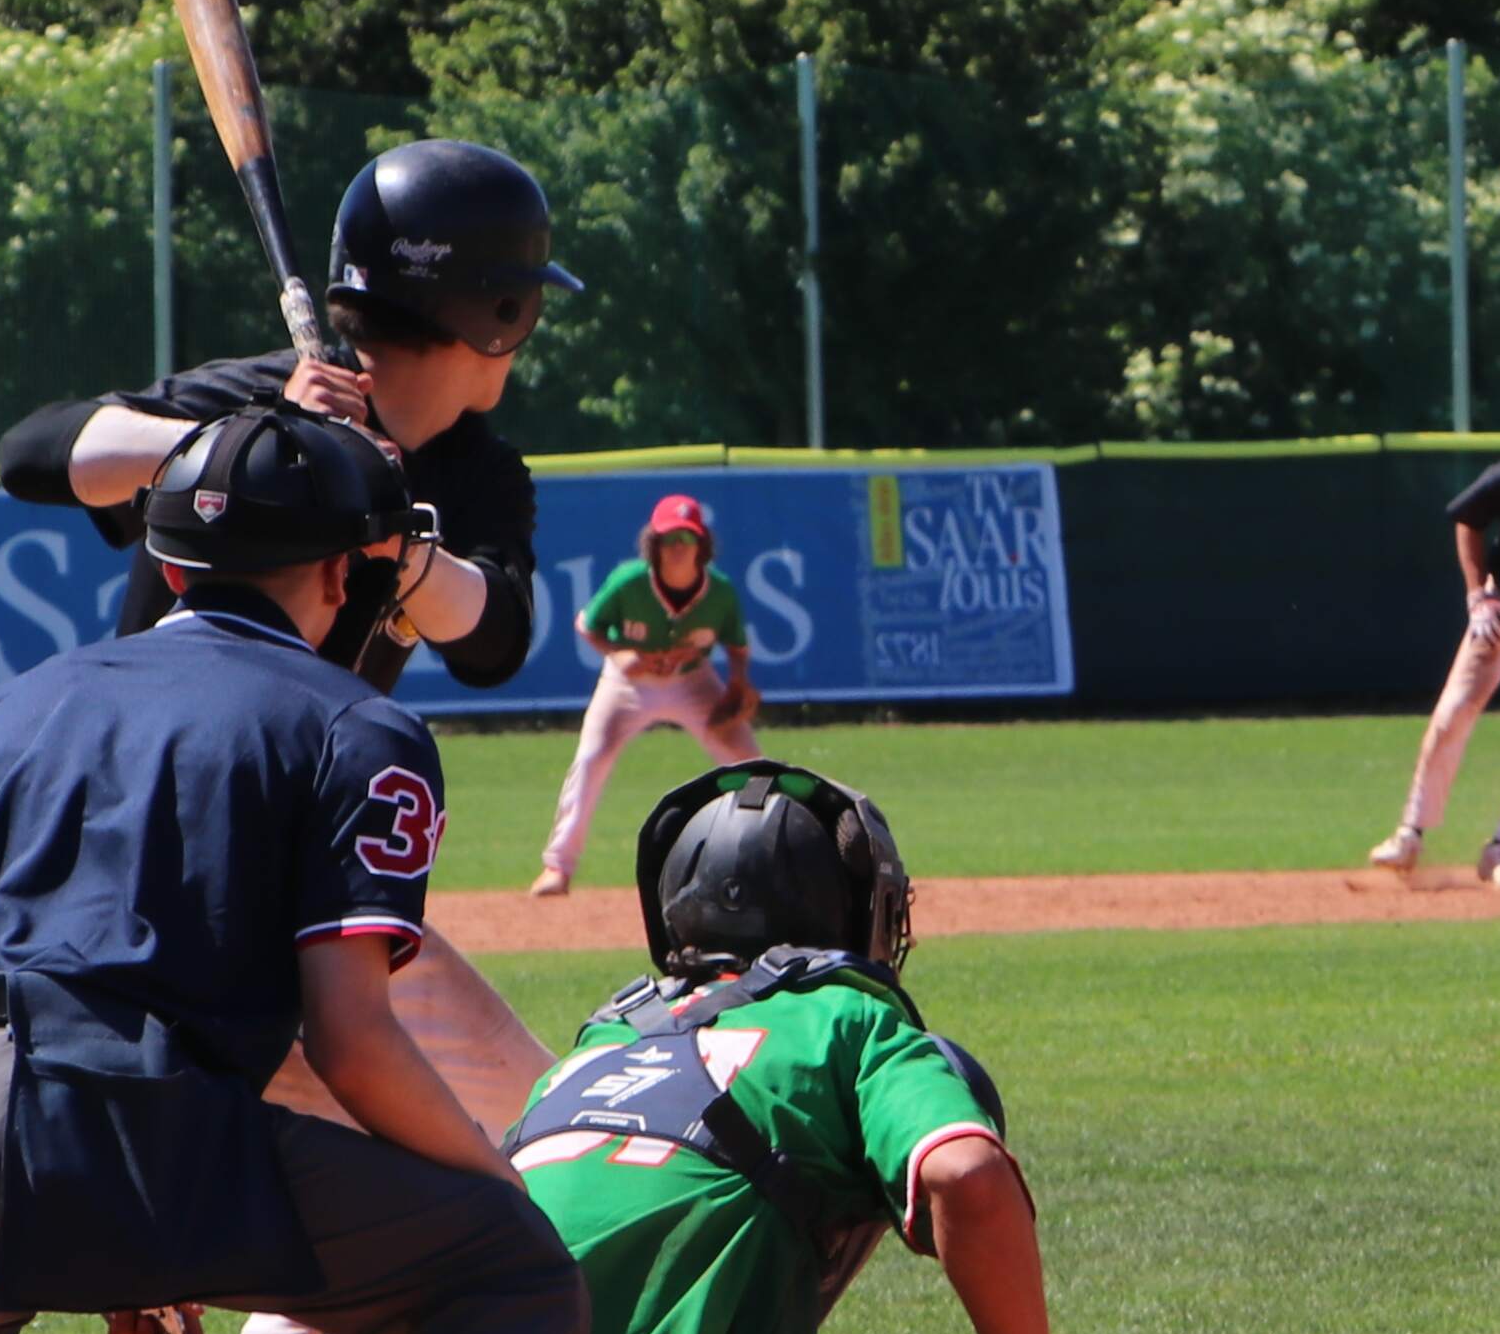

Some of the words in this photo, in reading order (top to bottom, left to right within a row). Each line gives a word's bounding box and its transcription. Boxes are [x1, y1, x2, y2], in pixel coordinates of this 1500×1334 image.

[390, 238, 452, 262] Rawlings
[965, 474, 1014, 517] TV
[904, 506, 1048, 571] SAAR
[939, 557, 1046, 614] louis
[354, 765, 448, 880] 3
